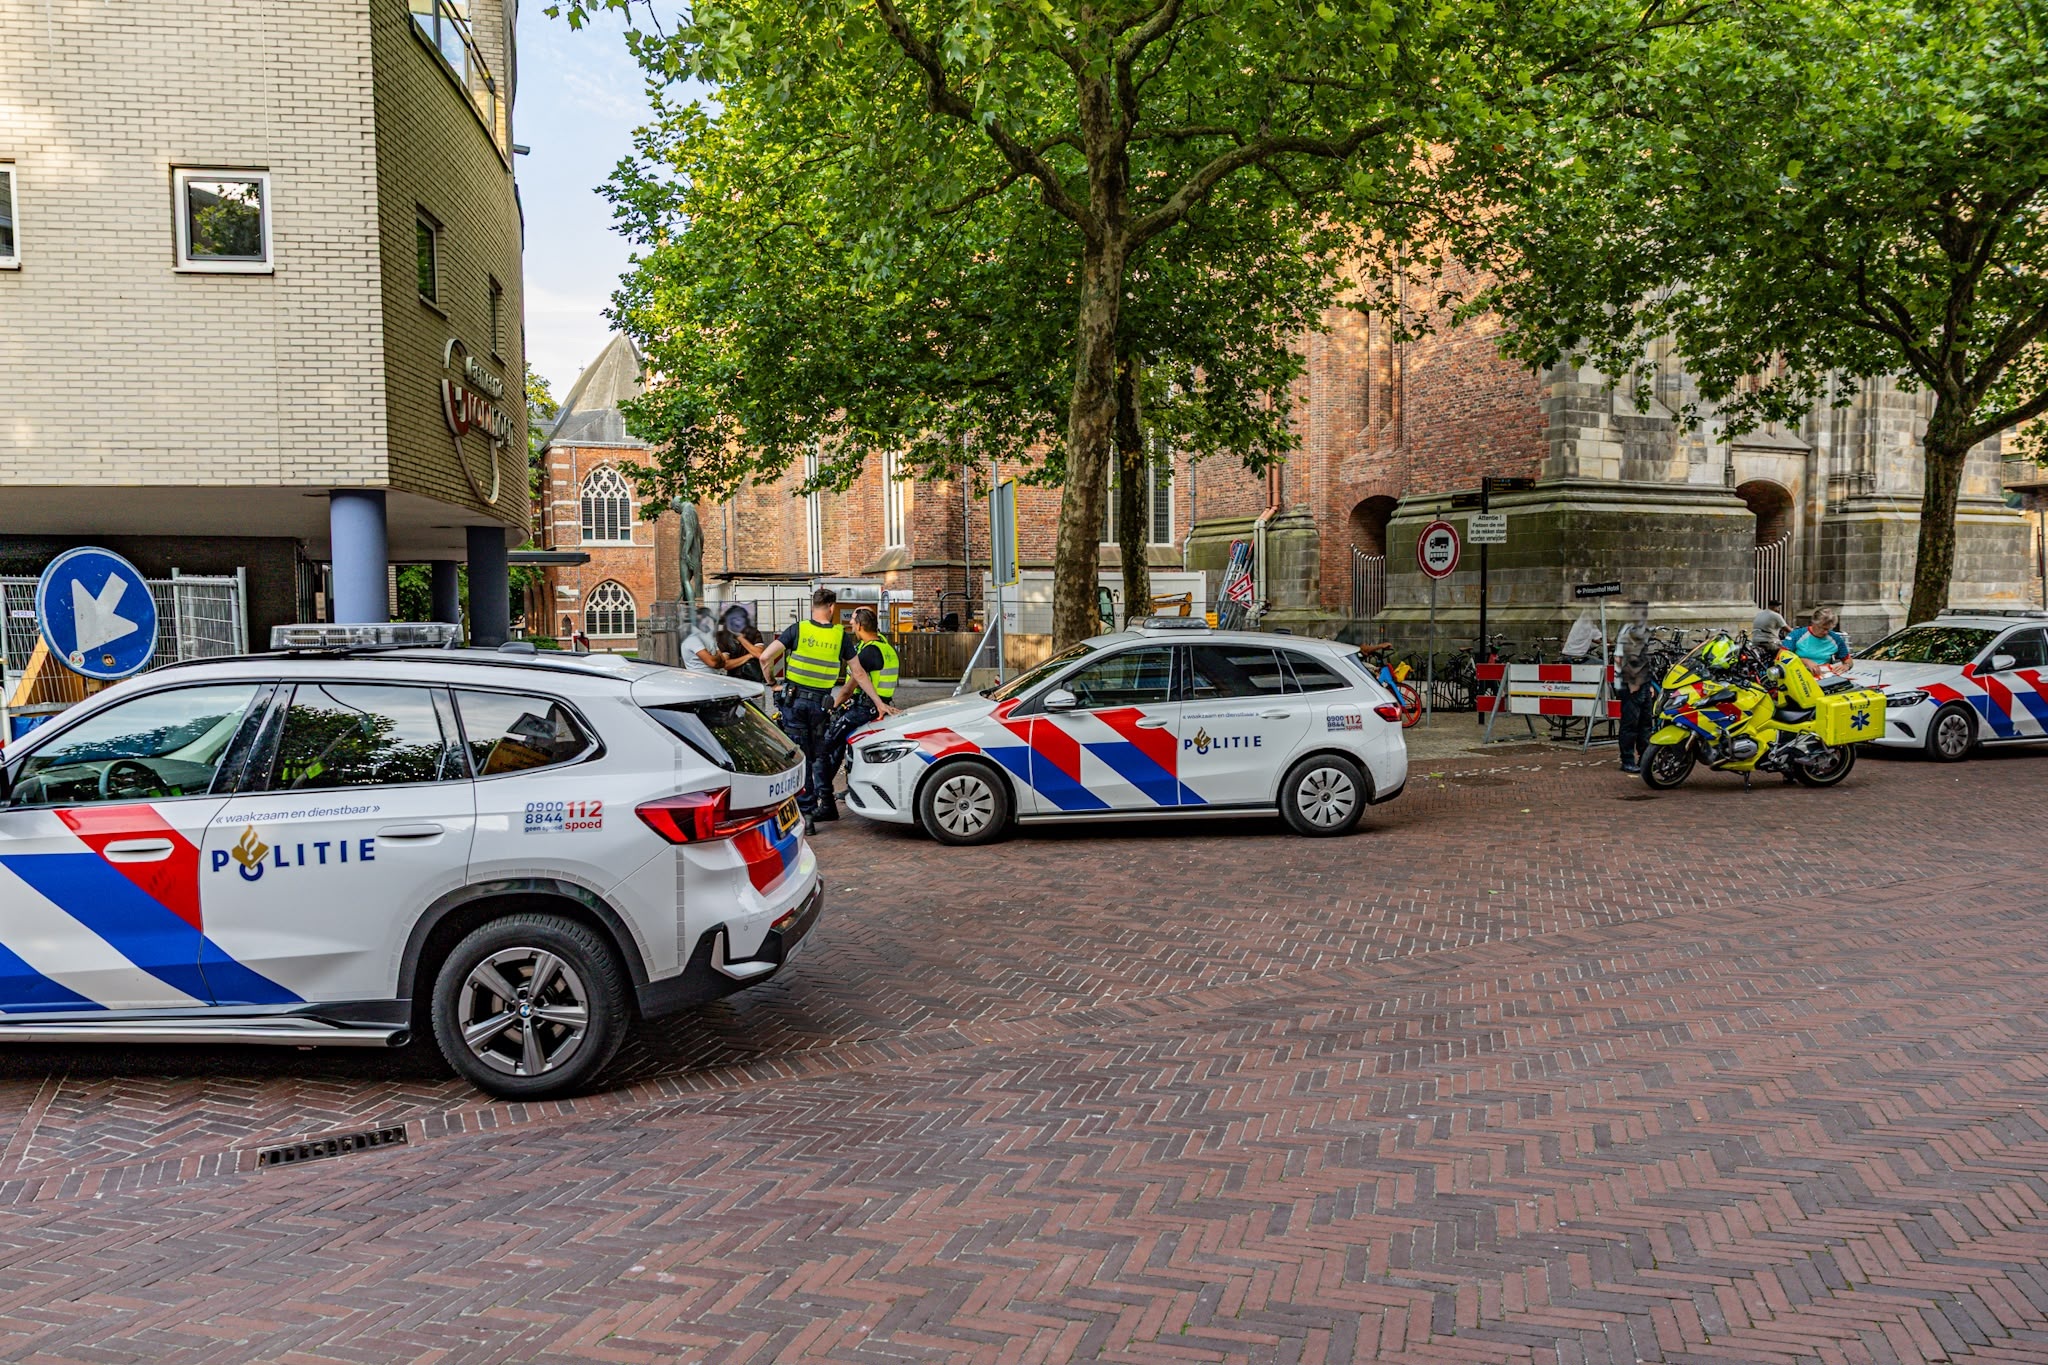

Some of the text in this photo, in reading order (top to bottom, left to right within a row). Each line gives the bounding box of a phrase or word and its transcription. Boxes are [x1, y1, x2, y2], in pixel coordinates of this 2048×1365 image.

[1607, 584, 1619, 592] Hotel
[802, 636, 838, 650] POLITIE
[1345, 715, 1362, 724] 112
[1184, 735, 1262, 755] POLITIE
[225, 811, 289, 824] waakzaam
[290, 809, 306, 818] en
[307, 804, 371, 817] dienstbaar
[526, 800, 603, 818] 0900 112
[525, 813, 602, 832] 8844 spoed
[211, 838, 376, 882] POLITIE
